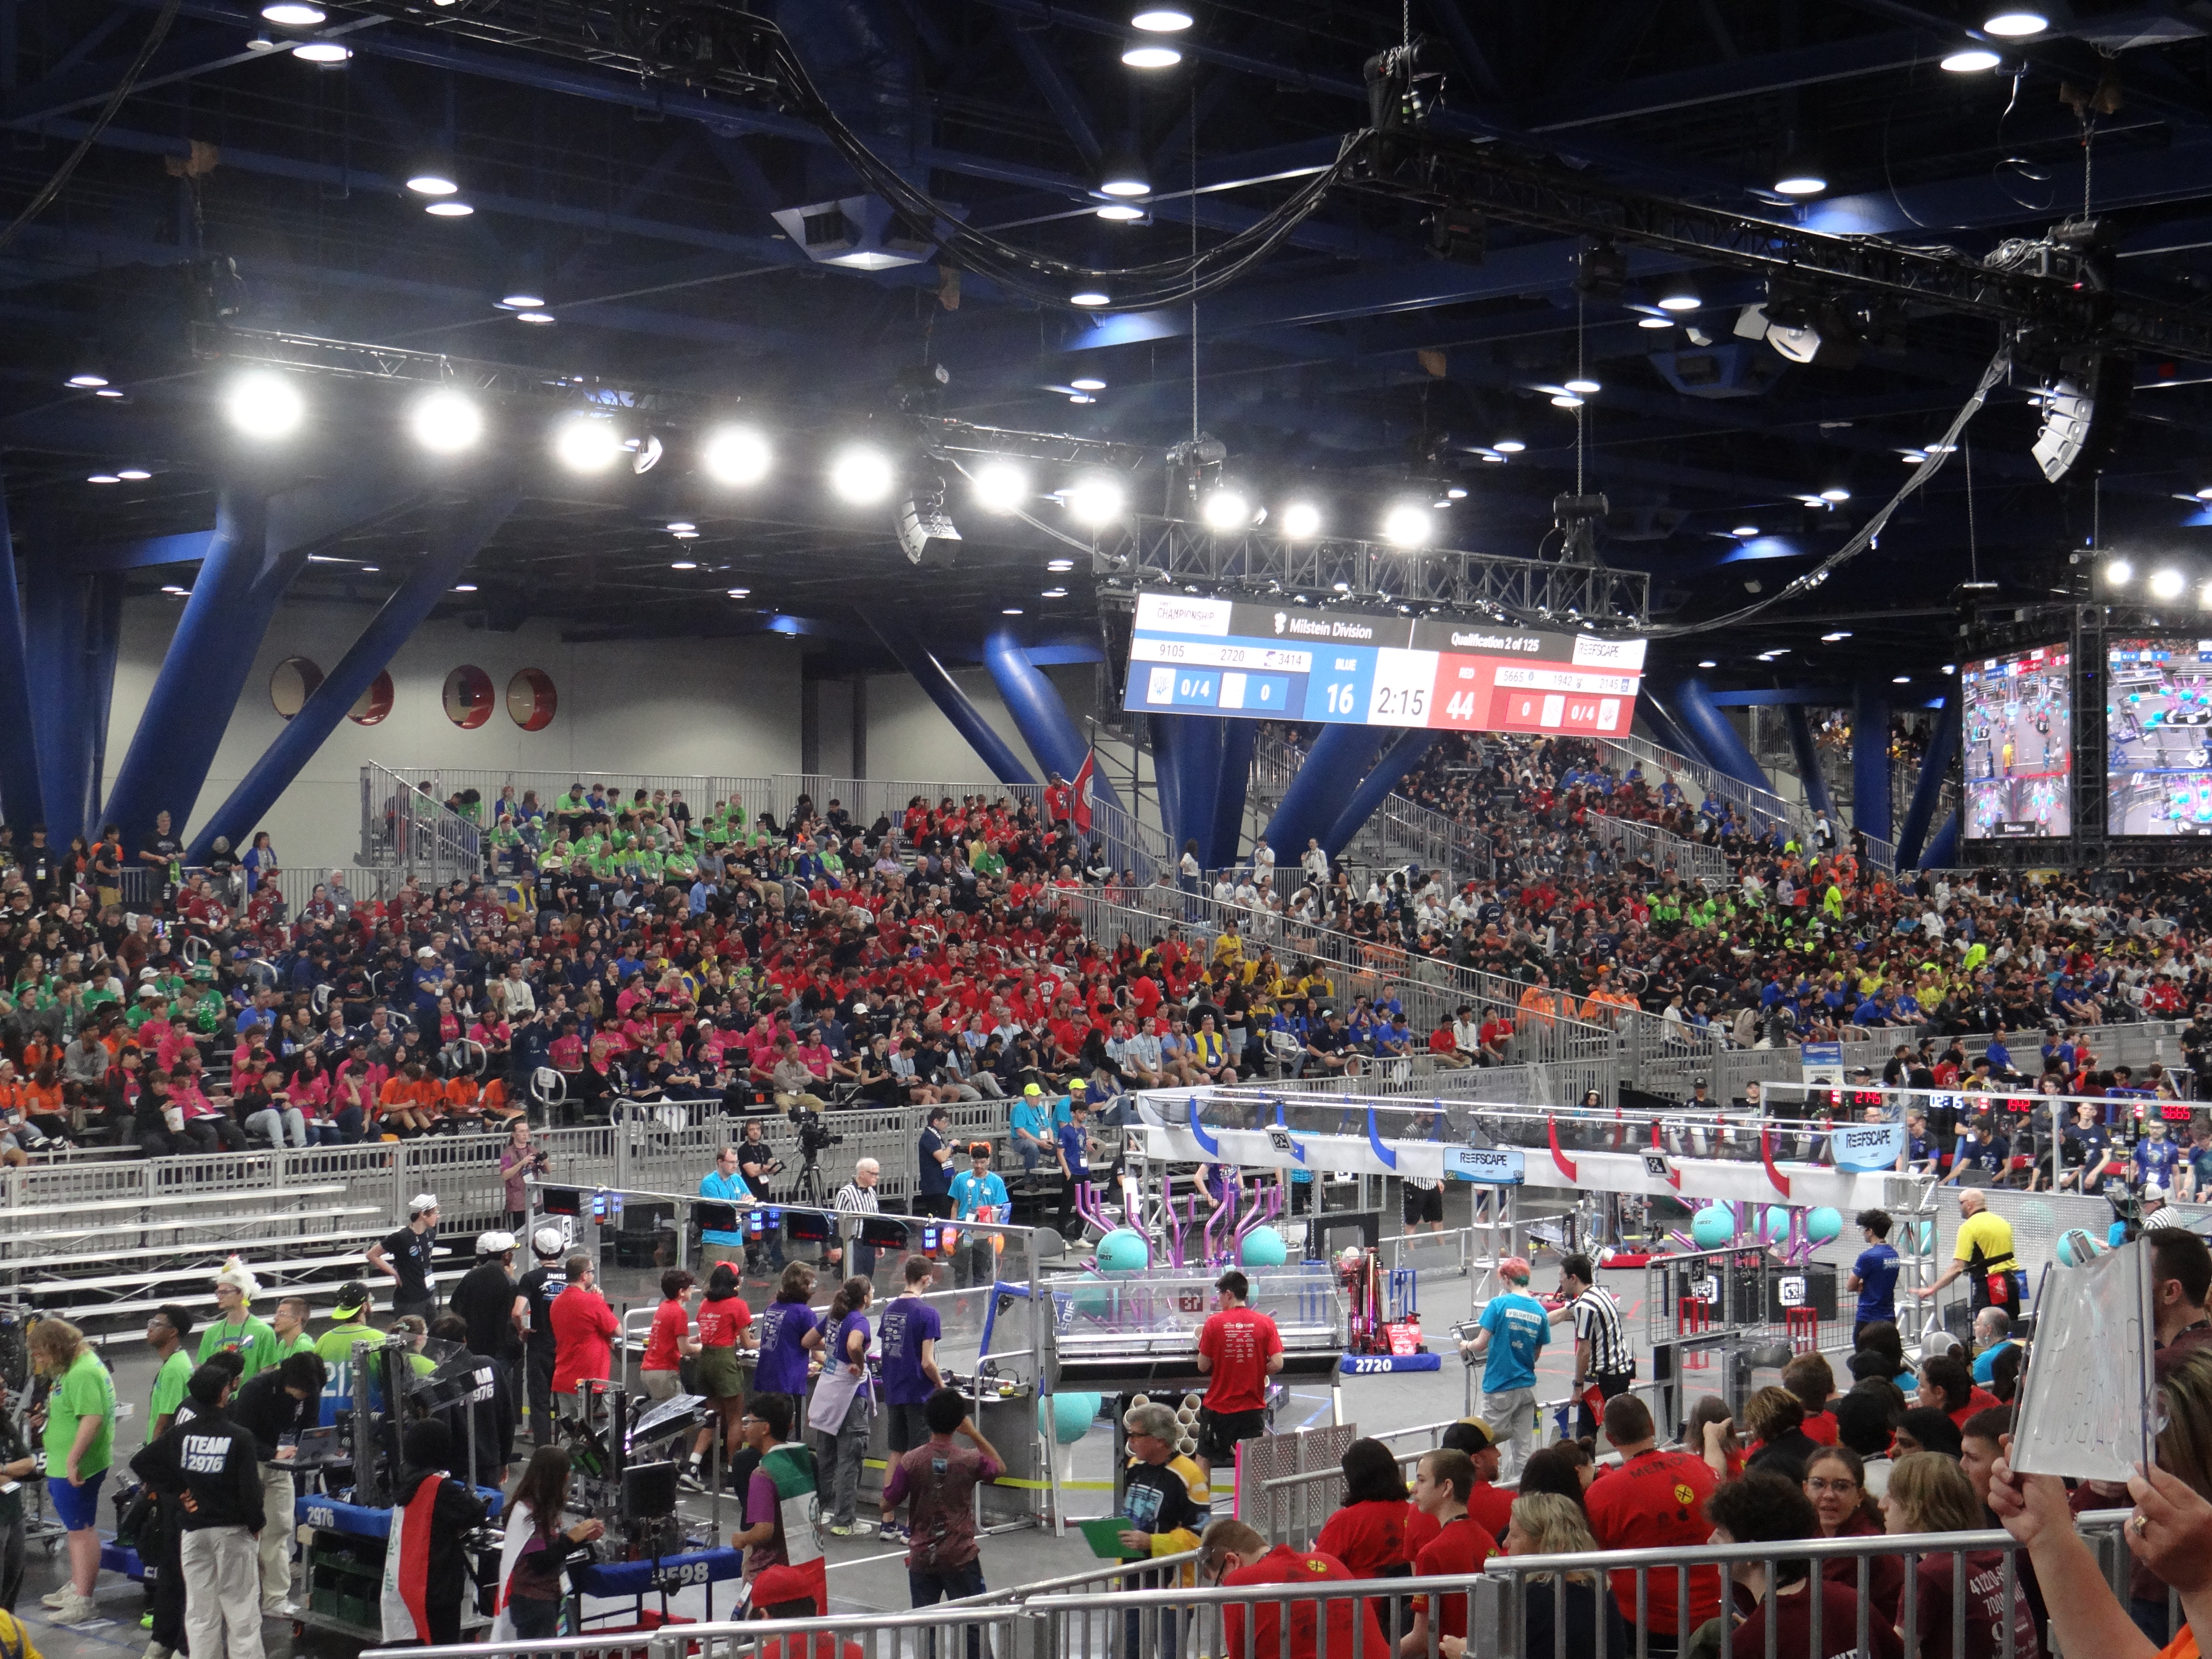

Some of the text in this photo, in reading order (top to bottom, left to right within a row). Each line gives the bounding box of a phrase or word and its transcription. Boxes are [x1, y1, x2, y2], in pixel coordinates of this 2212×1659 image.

[1158, 608, 1214, 621] CHAMPIONSHIP
[1290, 619, 1372, 639] Milstein Division
[1451, 632, 1539, 652] Qualification 2 of 125
[1578, 642, 1620, 657] REEFSCAPE
[1160, 644, 1185, 657] 9105
[1221, 649, 1244, 661] 2720
[1279, 654, 1302, 665] 3414
[1335, 658, 1357, 670] BLUE
[1458, 667, 1475, 679] RED
[1504, 670, 1524, 682] 5665
[1181, 679, 1209, 697] 0/4
[1554, 675, 1572, 687] 1942
[1599, 679, 1618, 689] 2145
[1261, 684, 1270, 701] 0
[1327, 684, 1354, 714] 16
[1377, 687, 1425, 716] 2:15
[1447, 691, 1474, 720] 44
[1522, 702, 1530, 717] 0
[1571, 705, 1595, 720] 0/4
[1855, 1091, 1880, 1104] 2145
[2007, 1099, 2030, 1112] 1942
[2161, 1105, 2190, 1120] 5665
[1846, 1129, 1890, 1149] REEFSCAPE
[1460, 1152, 1507, 1166] REEFSCAPE
[1509, 1311, 1540, 1322] VOLUNTEER
[1356, 1359, 1392, 1372] 2720
[472, 1383, 494, 1401] 976
[189, 1435, 232, 1455] TEAM
[187, 1454, 224, 1473] 2976
[307, 1506, 334, 1528] 2976
